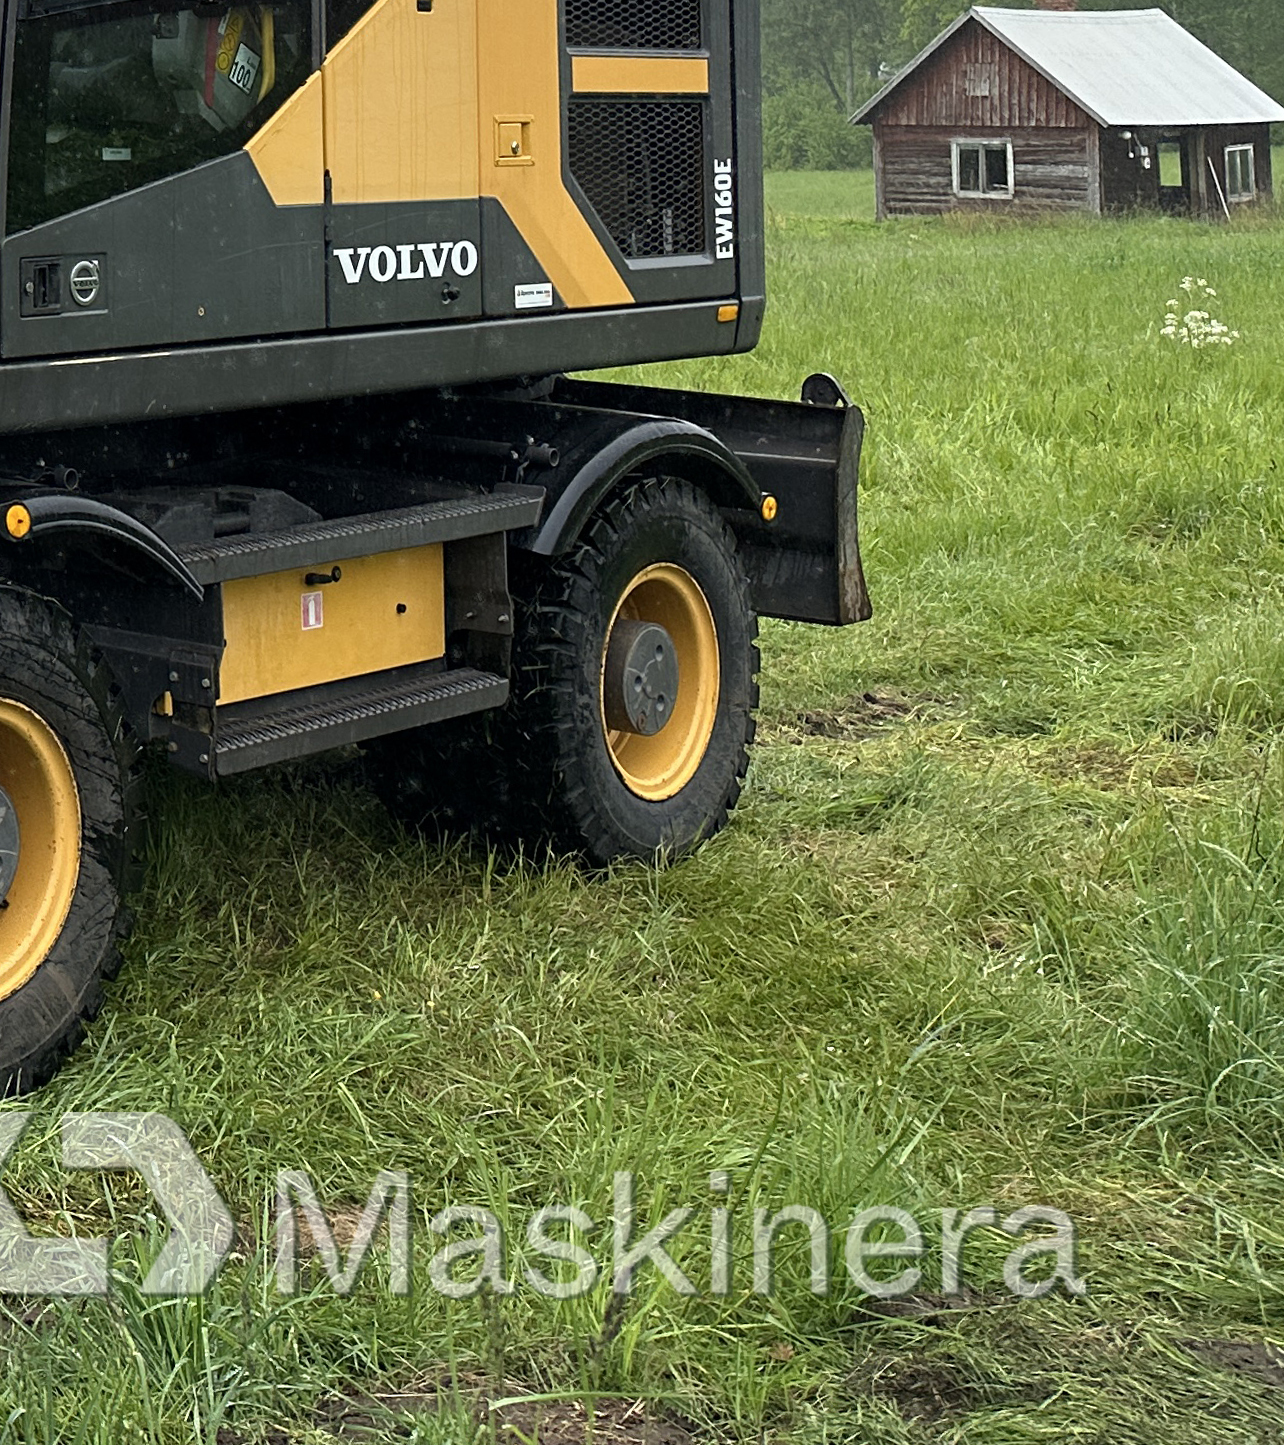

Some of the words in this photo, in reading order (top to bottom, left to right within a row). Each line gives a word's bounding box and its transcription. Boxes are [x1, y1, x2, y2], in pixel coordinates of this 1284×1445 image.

[233, 61, 251, 87] 100
[714, 158, 734, 259] EW160E
[333, 240, 478, 284] VOLVO
